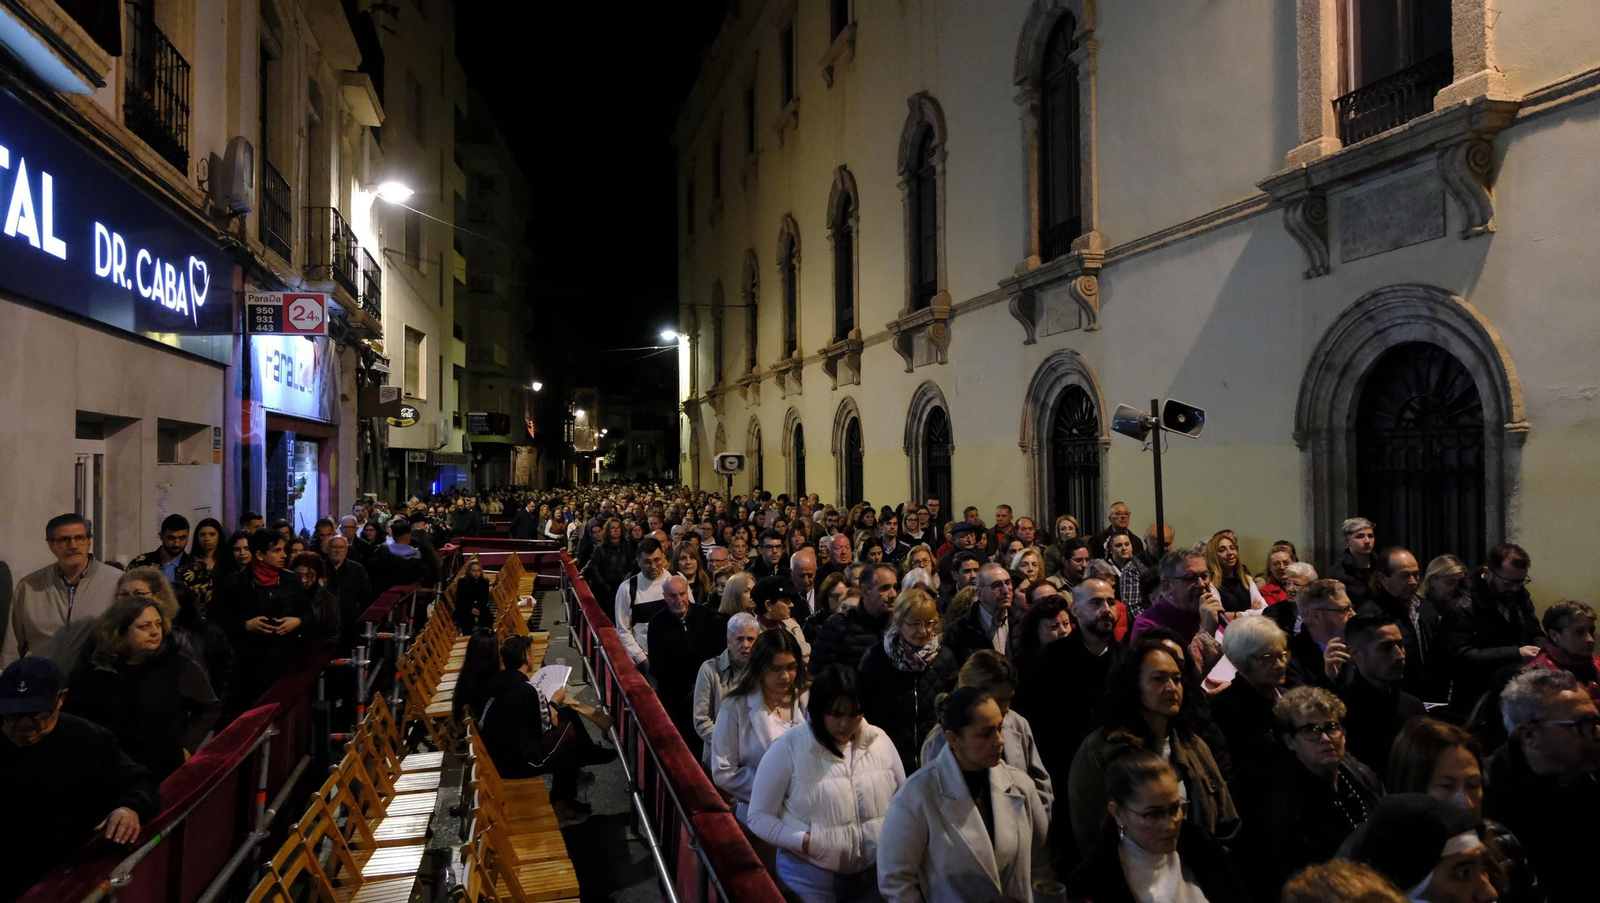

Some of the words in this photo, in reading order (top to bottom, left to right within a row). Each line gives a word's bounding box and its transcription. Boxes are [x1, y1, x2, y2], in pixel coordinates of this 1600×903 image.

[95, 221, 132, 290] DR.
[136, 248, 189, 316] CABA
[248, 294, 281, 303] ParaDa
[292, 305, 320, 321] 24h
[256, 315, 274, 323] 931
[256, 324, 274, 332] 443
